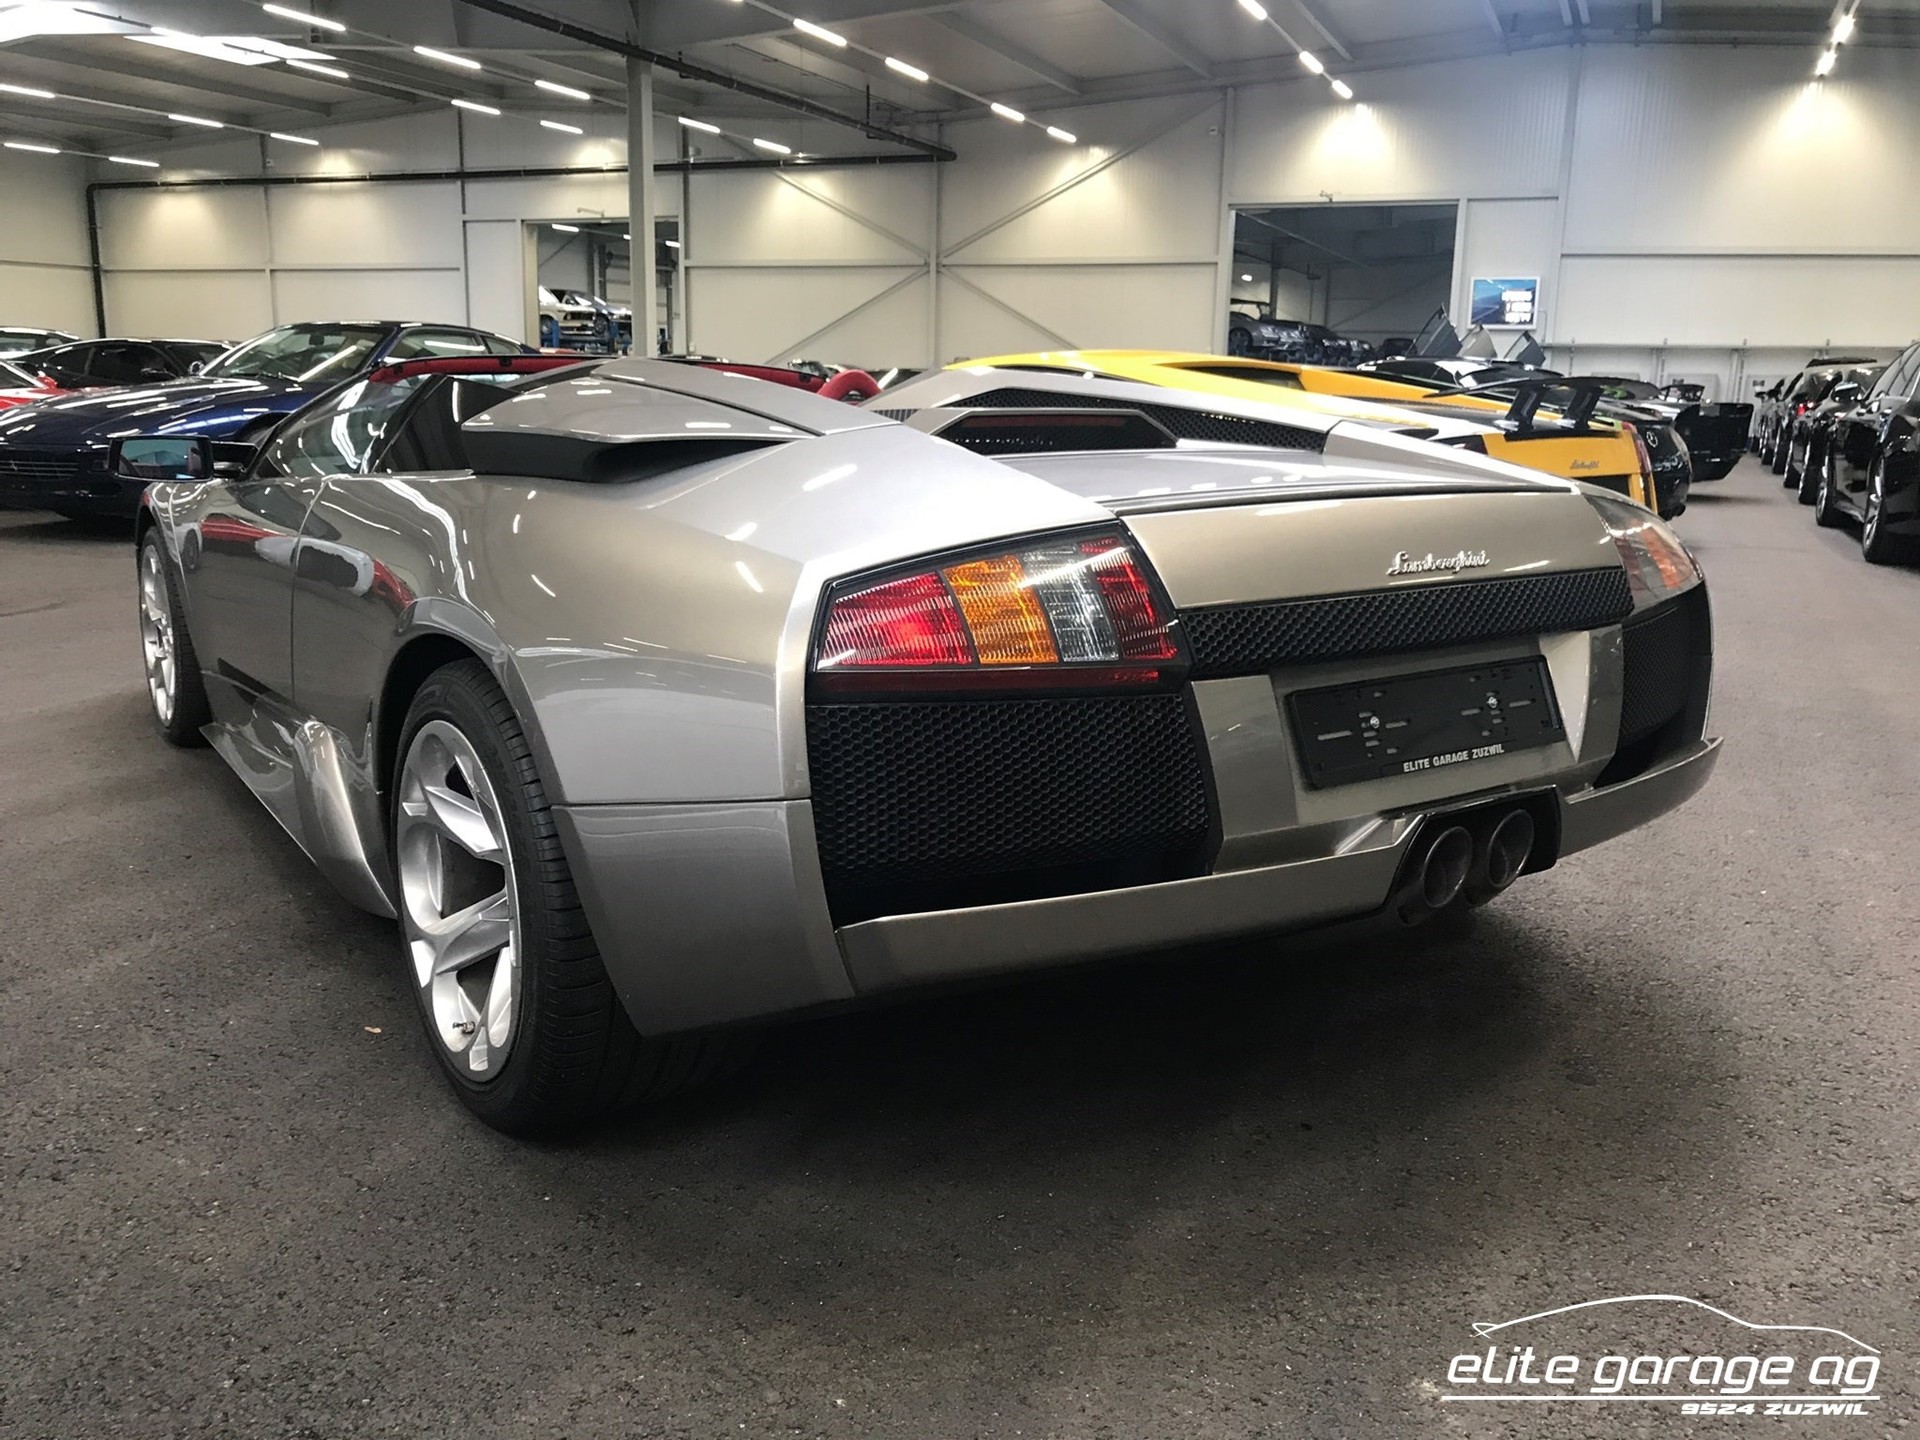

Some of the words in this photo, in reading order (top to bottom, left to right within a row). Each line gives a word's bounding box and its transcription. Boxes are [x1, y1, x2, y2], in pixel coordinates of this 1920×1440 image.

[1386, 550, 1491, 575] Lamborghini
[1403, 757, 1431, 773] ELITE
[1432, 750, 1470, 767] GARAGE
[1471, 743, 1505, 760] ZUZWIL
